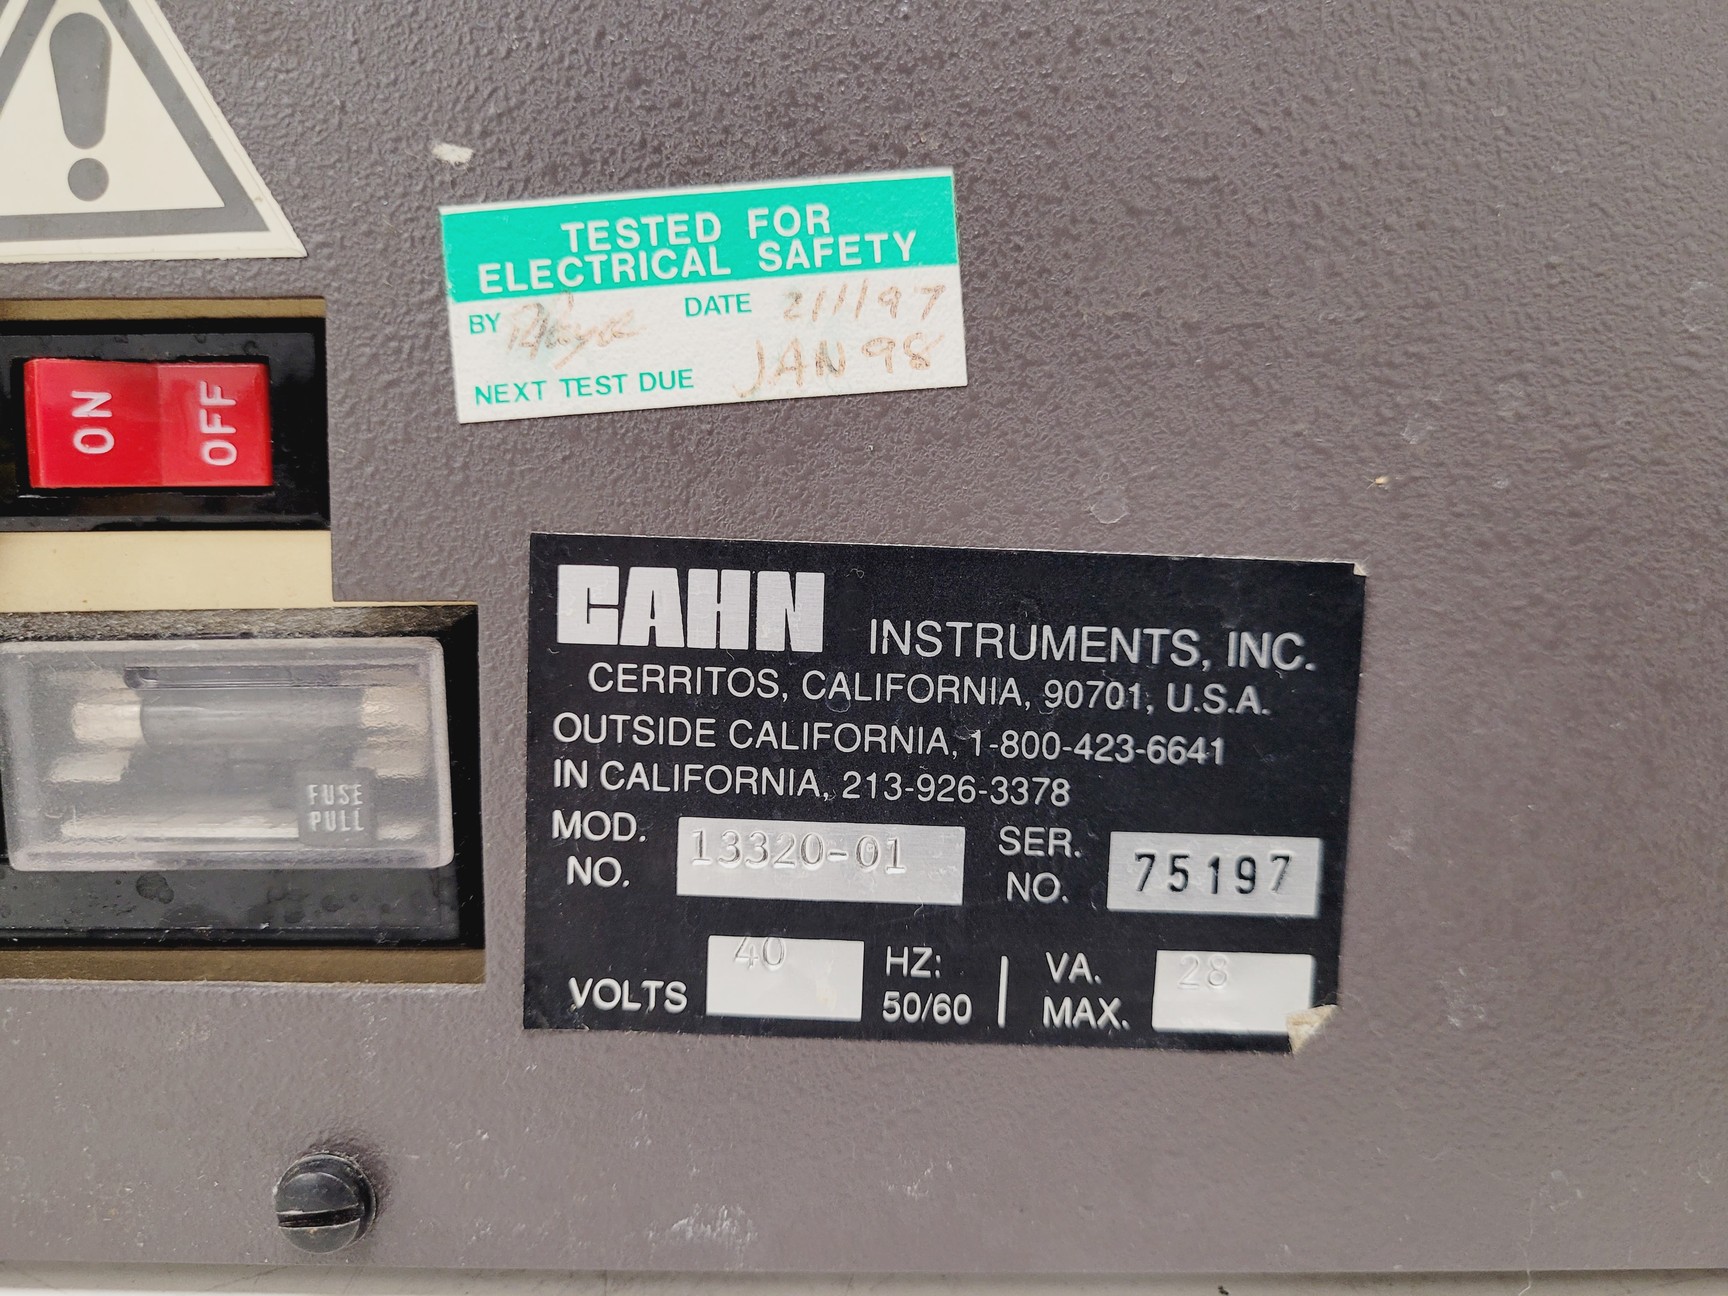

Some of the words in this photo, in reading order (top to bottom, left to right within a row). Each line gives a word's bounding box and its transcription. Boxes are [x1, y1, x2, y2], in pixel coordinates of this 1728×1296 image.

[560, 211, 722, 253] TESTED
[747, 202, 831, 241] FOR
[477, 245, 731, 295] ELECTRICAL
[757, 230, 917, 273] SAFETY
[469, 312, 501, 335] BY
[684, 293, 752, 319] DATE
[732, 337, 847, 398] JAN
[861, 331, 945, 374] 98
[474, 380, 547, 405] NEXT
[559, 373, 628, 398] TEST
[639, 368, 694, 392] DUE
[71, 390, 115, 455] ON
[199, 380, 238, 466] OFF
[556, 564, 825, 653] CAHN
[869, 618, 1211, 672] INSTRUMENTS,
[1227, 630, 1317, 672] INC.
[587, 662, 789, 703] CERRITOS,
[801, 669, 1031, 711] CALIFORNIA,
[1043, 679, 1154, 716] 90701,
[1166, 683, 1271, 716] U.S.A.
[553, 711, 717, 748] OUTSIDE
[728, 719, 958, 760] CALIFORNIA,
[971, 729, 1226, 767] 1-800-423-6641
[307, 783, 364, 805] FUSE
[552, 758, 588, 790] IN
[599, 760, 830, 801] CALIFORNIA,
[842, 771, 1071, 808] 213-926-3378
[308, 809, 365, 832] PULL
[551, 809, 647, 843] MOD.
[690, 827, 908, 876] 13320-01
[998, 825, 1082, 859] SER.
[566, 855, 630, 888] NO.
[1006, 871, 1069, 904] NO.
[1134, 848, 1294, 895] 75197
[568, 976, 688, 1014] VOLTS
[732, 935, 787, 972] 40
[886, 945, 942, 980] HZ:
[1045, 951, 1102, 985] VA.
[1176, 953, 1231, 990] 28
[882, 990, 973, 1025] 50/60
[1043, 995, 1131, 1030] MAX.
